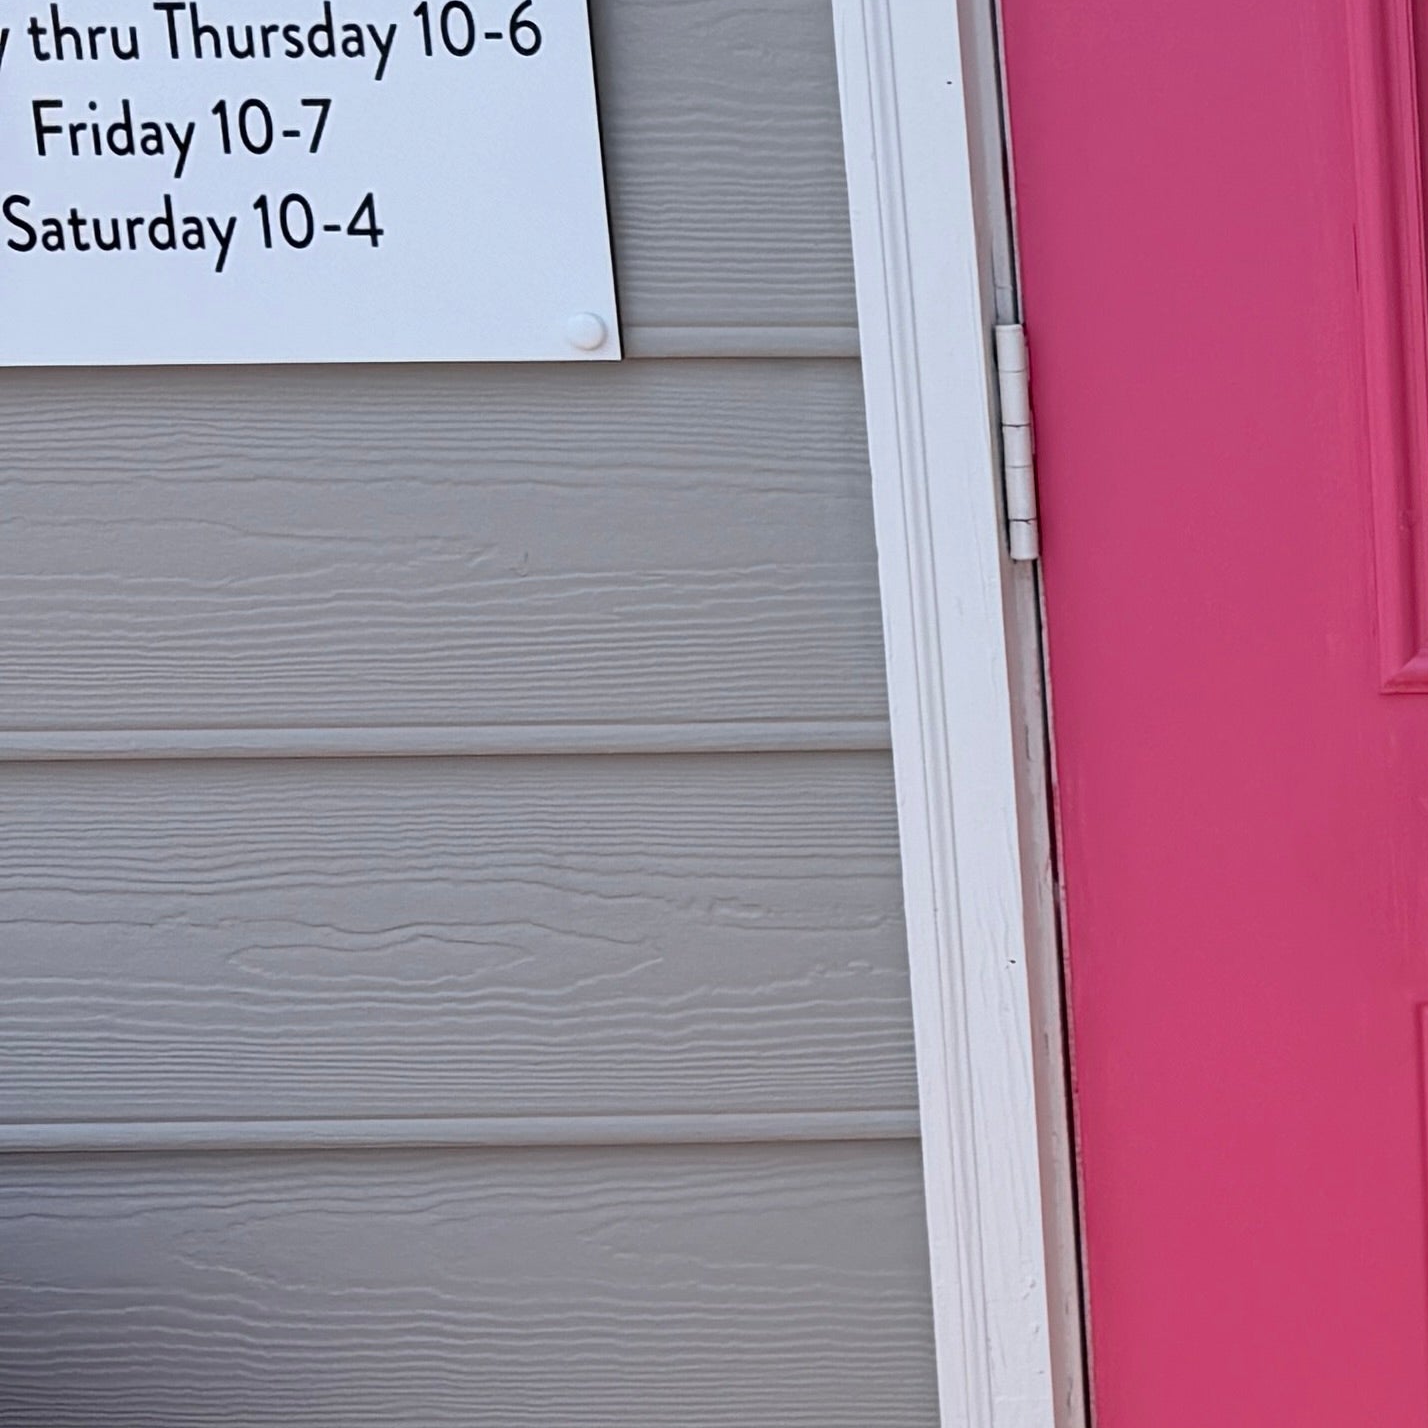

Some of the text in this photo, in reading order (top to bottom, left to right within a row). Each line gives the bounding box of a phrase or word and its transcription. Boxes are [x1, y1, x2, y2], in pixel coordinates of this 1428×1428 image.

[27, 2, 140, 62] thru
[152, 0, 397, 81] Thursday
[31, 98, 332, 179] Friday 10-7
[2, 192, 384, 273] Saturday 10-4
